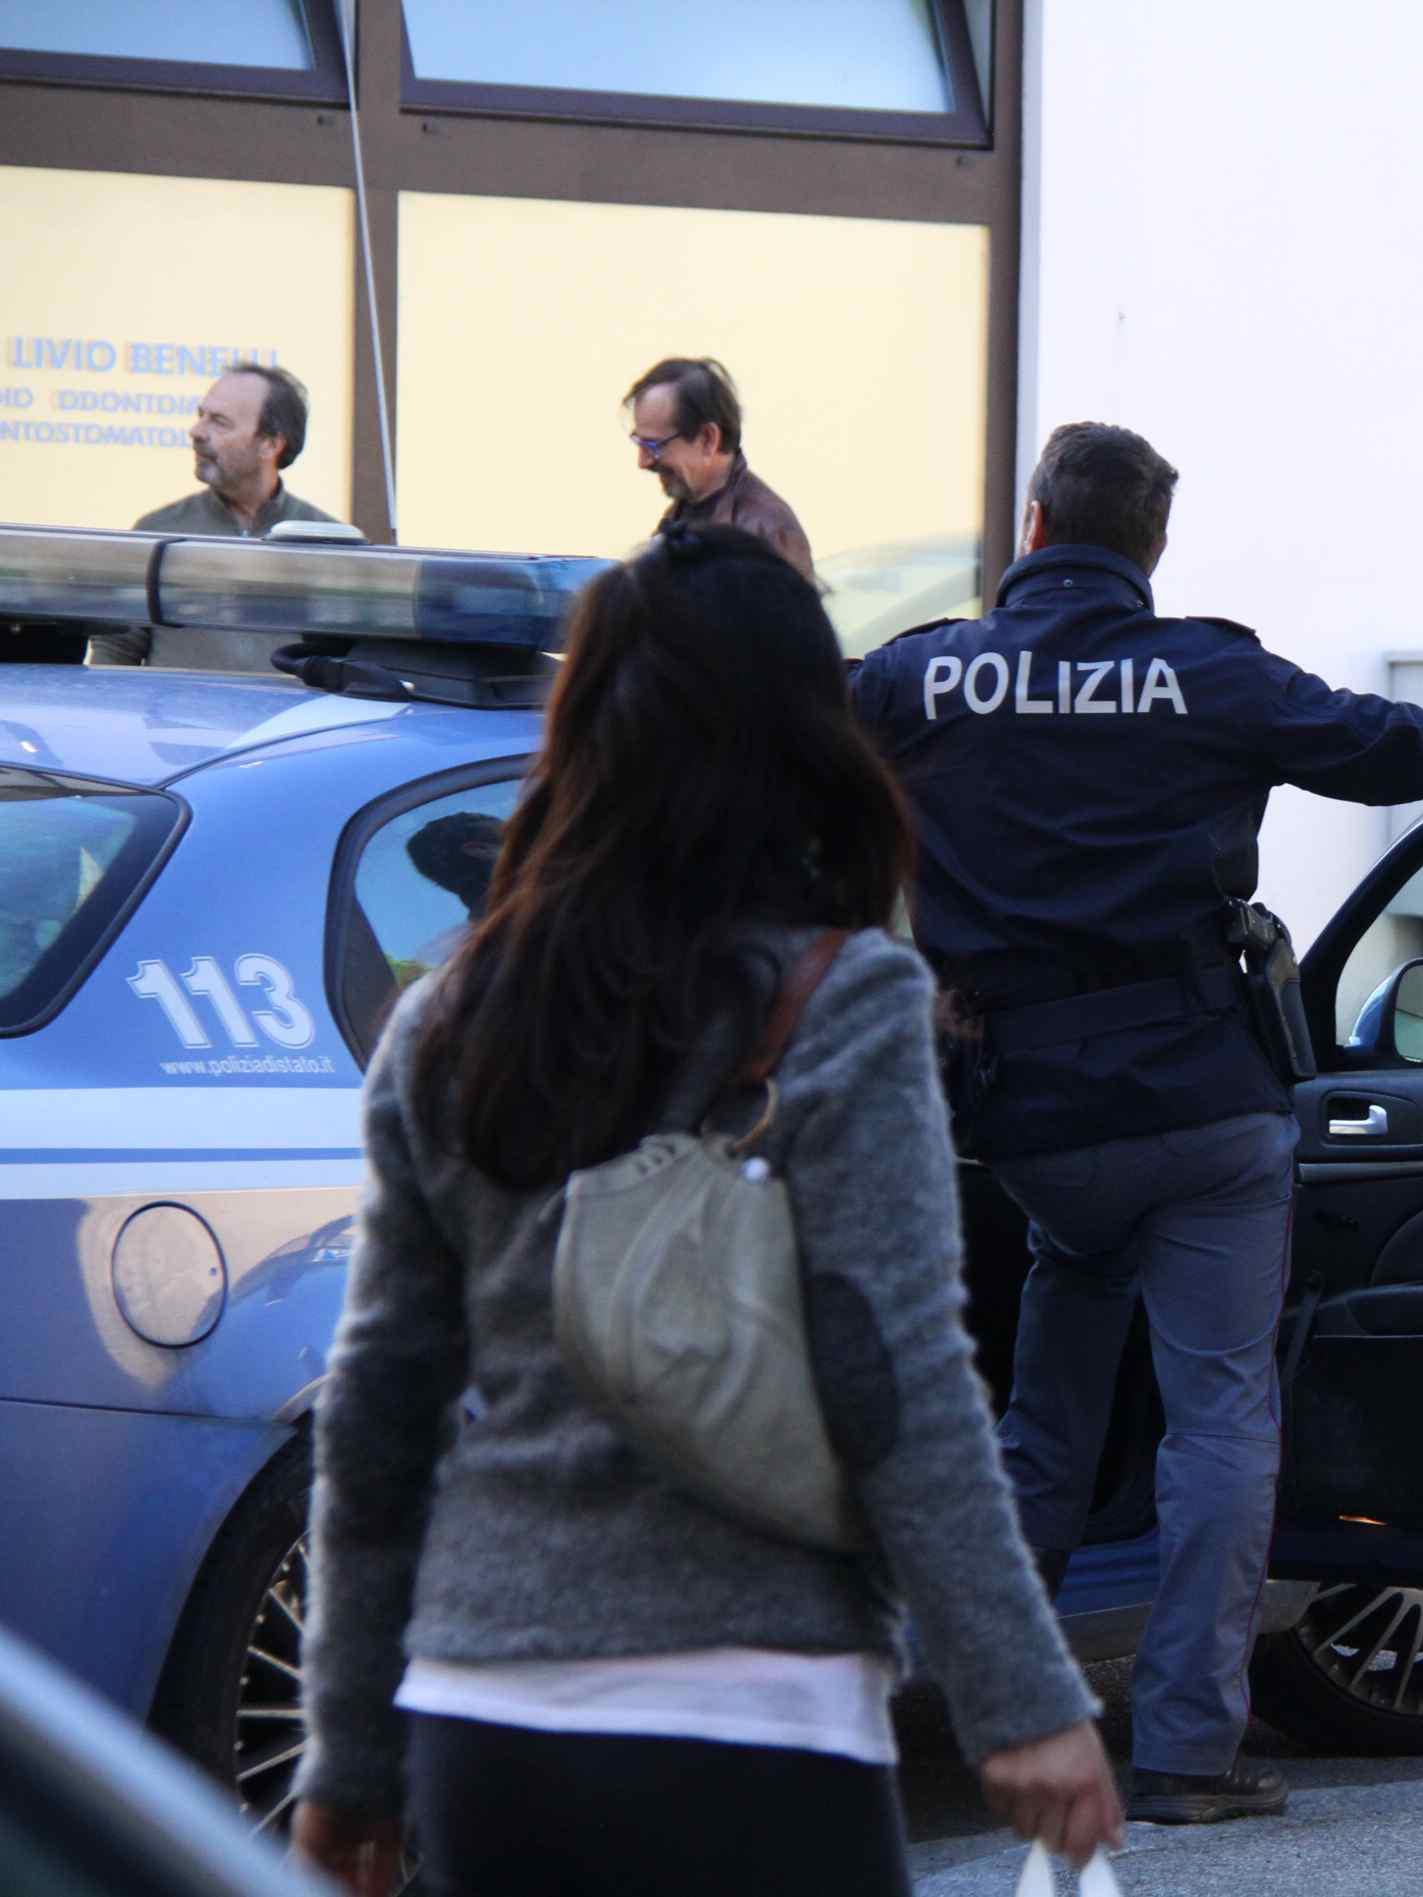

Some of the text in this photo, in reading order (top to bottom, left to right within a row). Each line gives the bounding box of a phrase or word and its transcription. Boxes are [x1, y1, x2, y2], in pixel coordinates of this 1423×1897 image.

[11, 336, 117, 372] LIVIO
[923, 650, 1188, 720] POLIZIA
[126, 952, 315, 1050] 113
